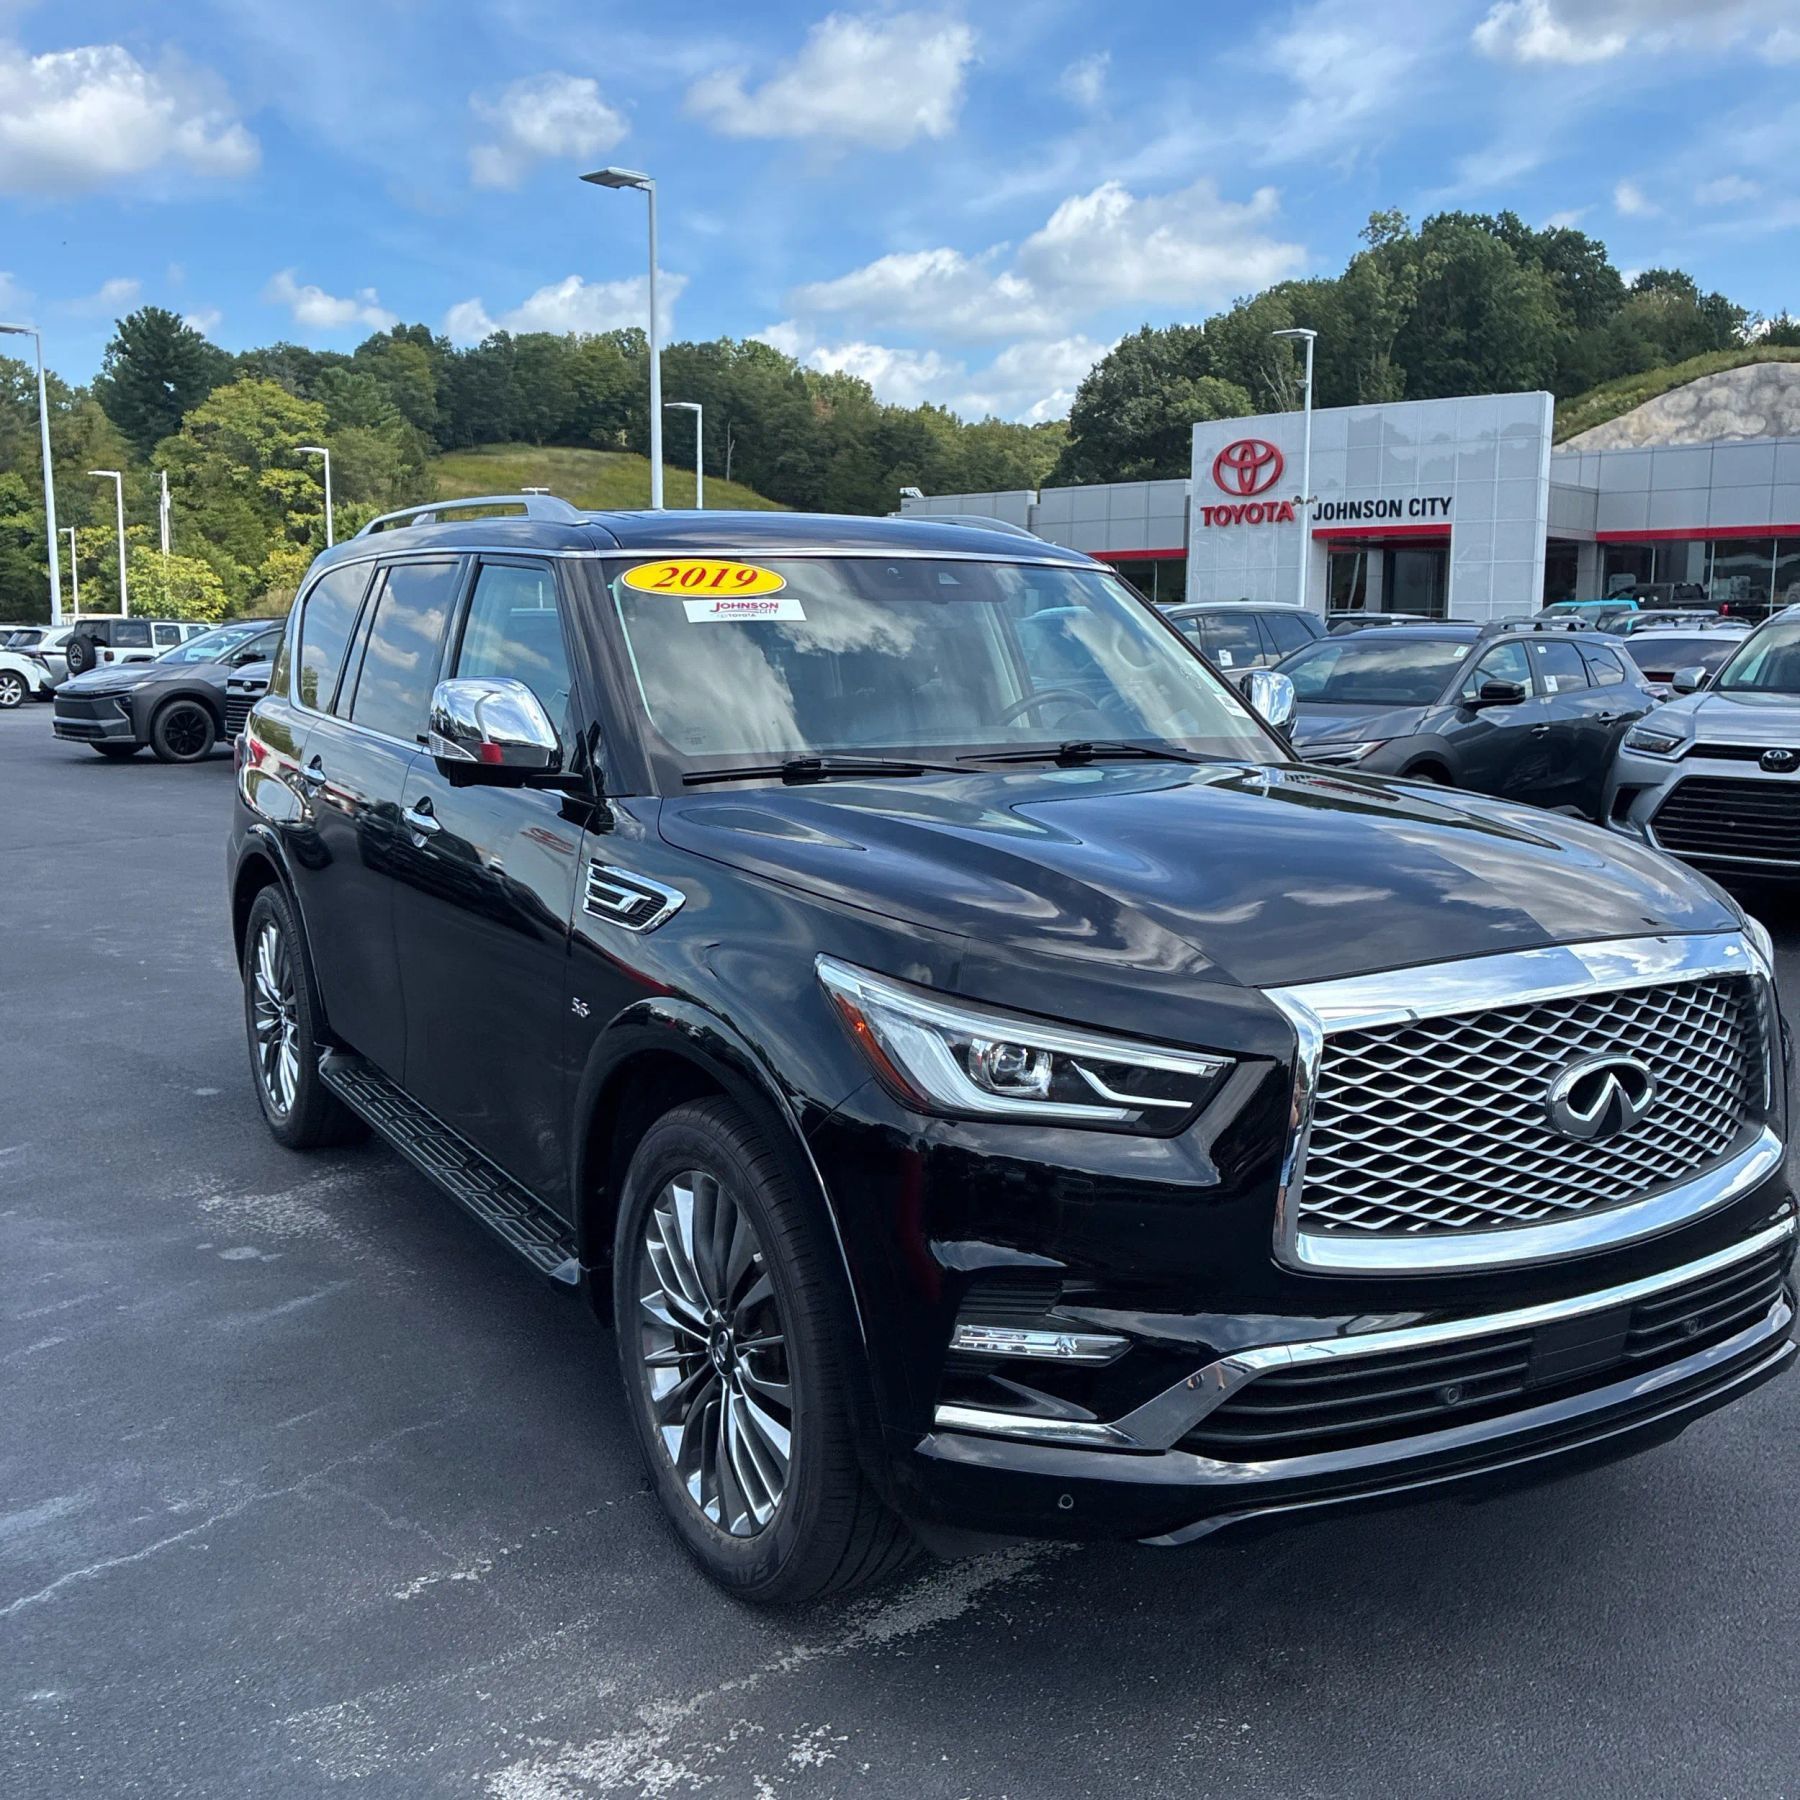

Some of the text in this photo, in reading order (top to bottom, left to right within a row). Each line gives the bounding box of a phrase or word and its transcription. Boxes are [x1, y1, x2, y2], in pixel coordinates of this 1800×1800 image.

[1200, 501, 1295, 527] TOYOTA
[1312, 496, 1453, 521] JOHNSON CITY
[651, 566, 759, 589] 2019
[709, 602, 779, 613] JOHNSON
